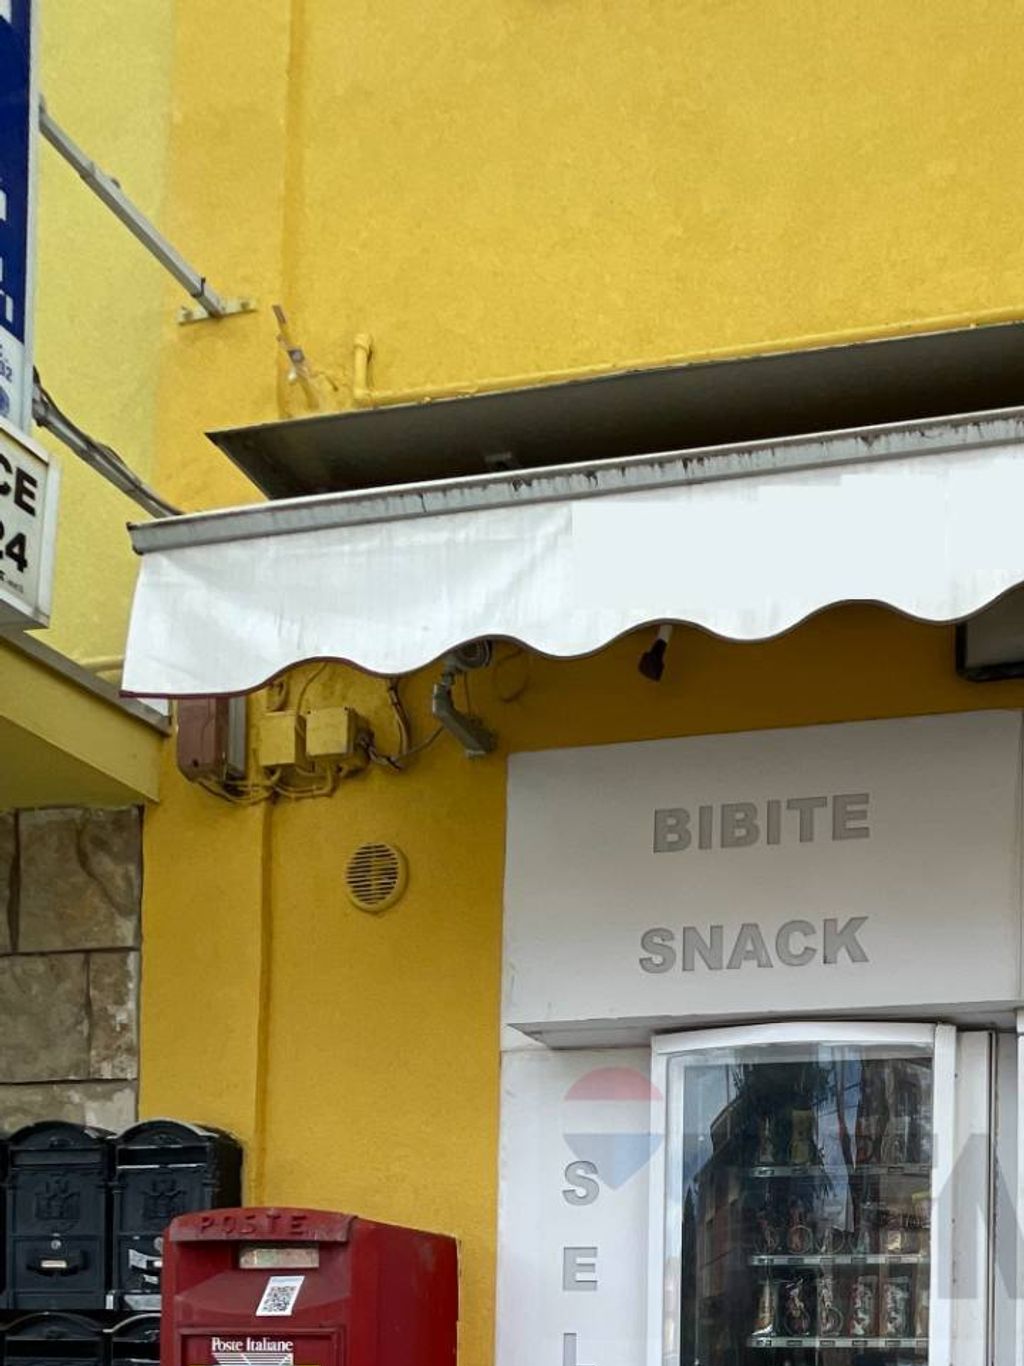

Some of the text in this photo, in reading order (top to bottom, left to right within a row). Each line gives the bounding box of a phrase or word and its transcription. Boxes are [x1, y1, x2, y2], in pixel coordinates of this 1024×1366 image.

[653, 793, 870, 854] BIBITE
[639, 916, 870, 974] SNACK
[199, 1214, 308, 1236] POSTE
[211, 1336, 294, 1351] Poste Italiane
